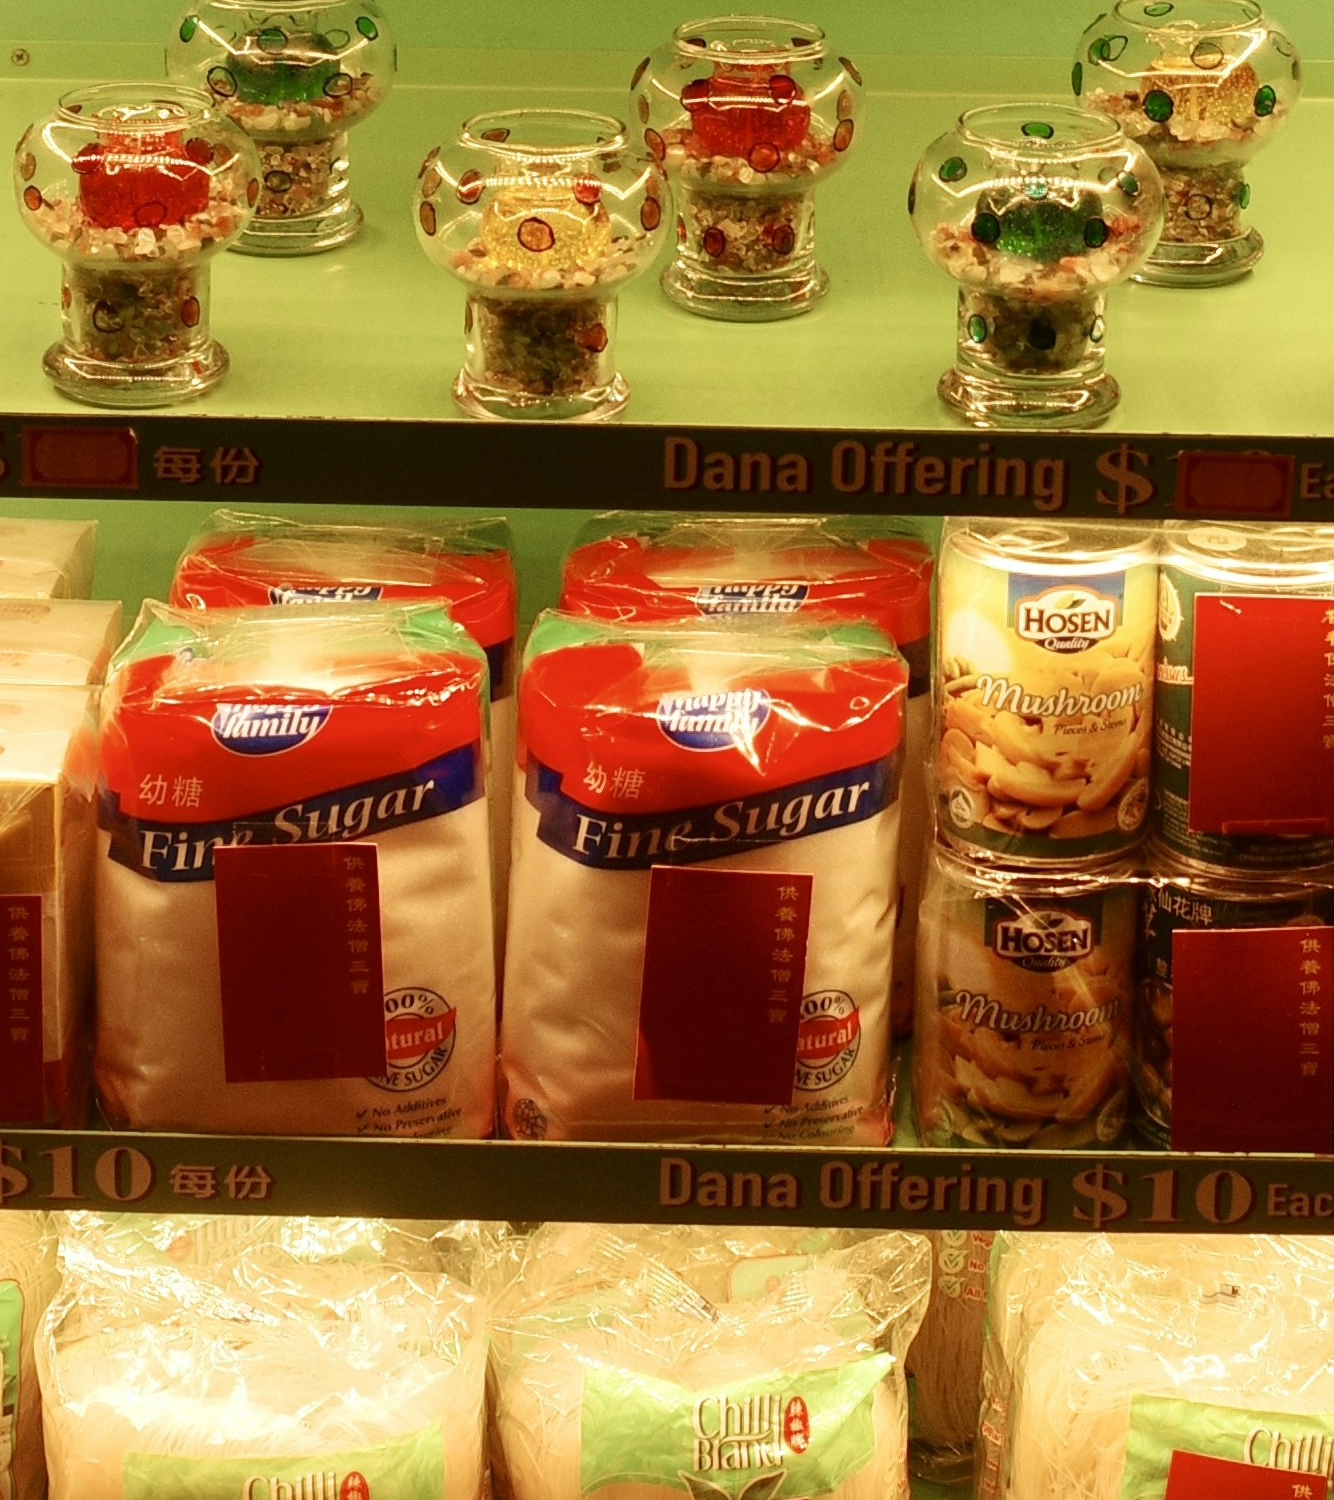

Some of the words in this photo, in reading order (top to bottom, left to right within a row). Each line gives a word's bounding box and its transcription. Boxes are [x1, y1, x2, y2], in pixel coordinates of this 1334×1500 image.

[153, 444, 264, 486] 每份
[663, 436, 810, 494] Dana
[828, 439, 1069, 512] Offering
[1094, 443, 1155, 515] $
[1023, 607, 1111, 635] HOSEN
[1043, 636, 1091, 653] Quality
[976, 674, 1143, 717] Mushroom
[1053, 722, 1087, 736] Pieces
[1089, 721, 1099, 734] &
[138, 773, 204, 809] 幼糖
[582, 760, 646, 801] 幼糖
[273, 779, 435, 846] Sugar
[572, 813, 693, 861] Fine
[710, 780, 871, 843] Sugar
[999, 925, 1089, 953] HOSEN
[955, 989, 1121, 1032] Mushroom
[404, 1045, 448, 1087] SUGAR
[815, 1049, 855, 1086] SUGAR
[372, 1107, 392, 1119] No
[394, 1096, 448, 1115] Additives
[778, 1117, 797, 1129] No
[779, 1103, 798, 1114] No
[374, 1123, 392, 1133] No
[170, 1163, 276, 1199] 每份
[659, 1157, 799, 1211] Dana
[819, 1161, 1050, 1226] Offering
[1071, 1163, 1257, 1227] $10
[693, 1393, 783, 1440] Chilli
[1243, 1428, 1334, 1477] Chilli
